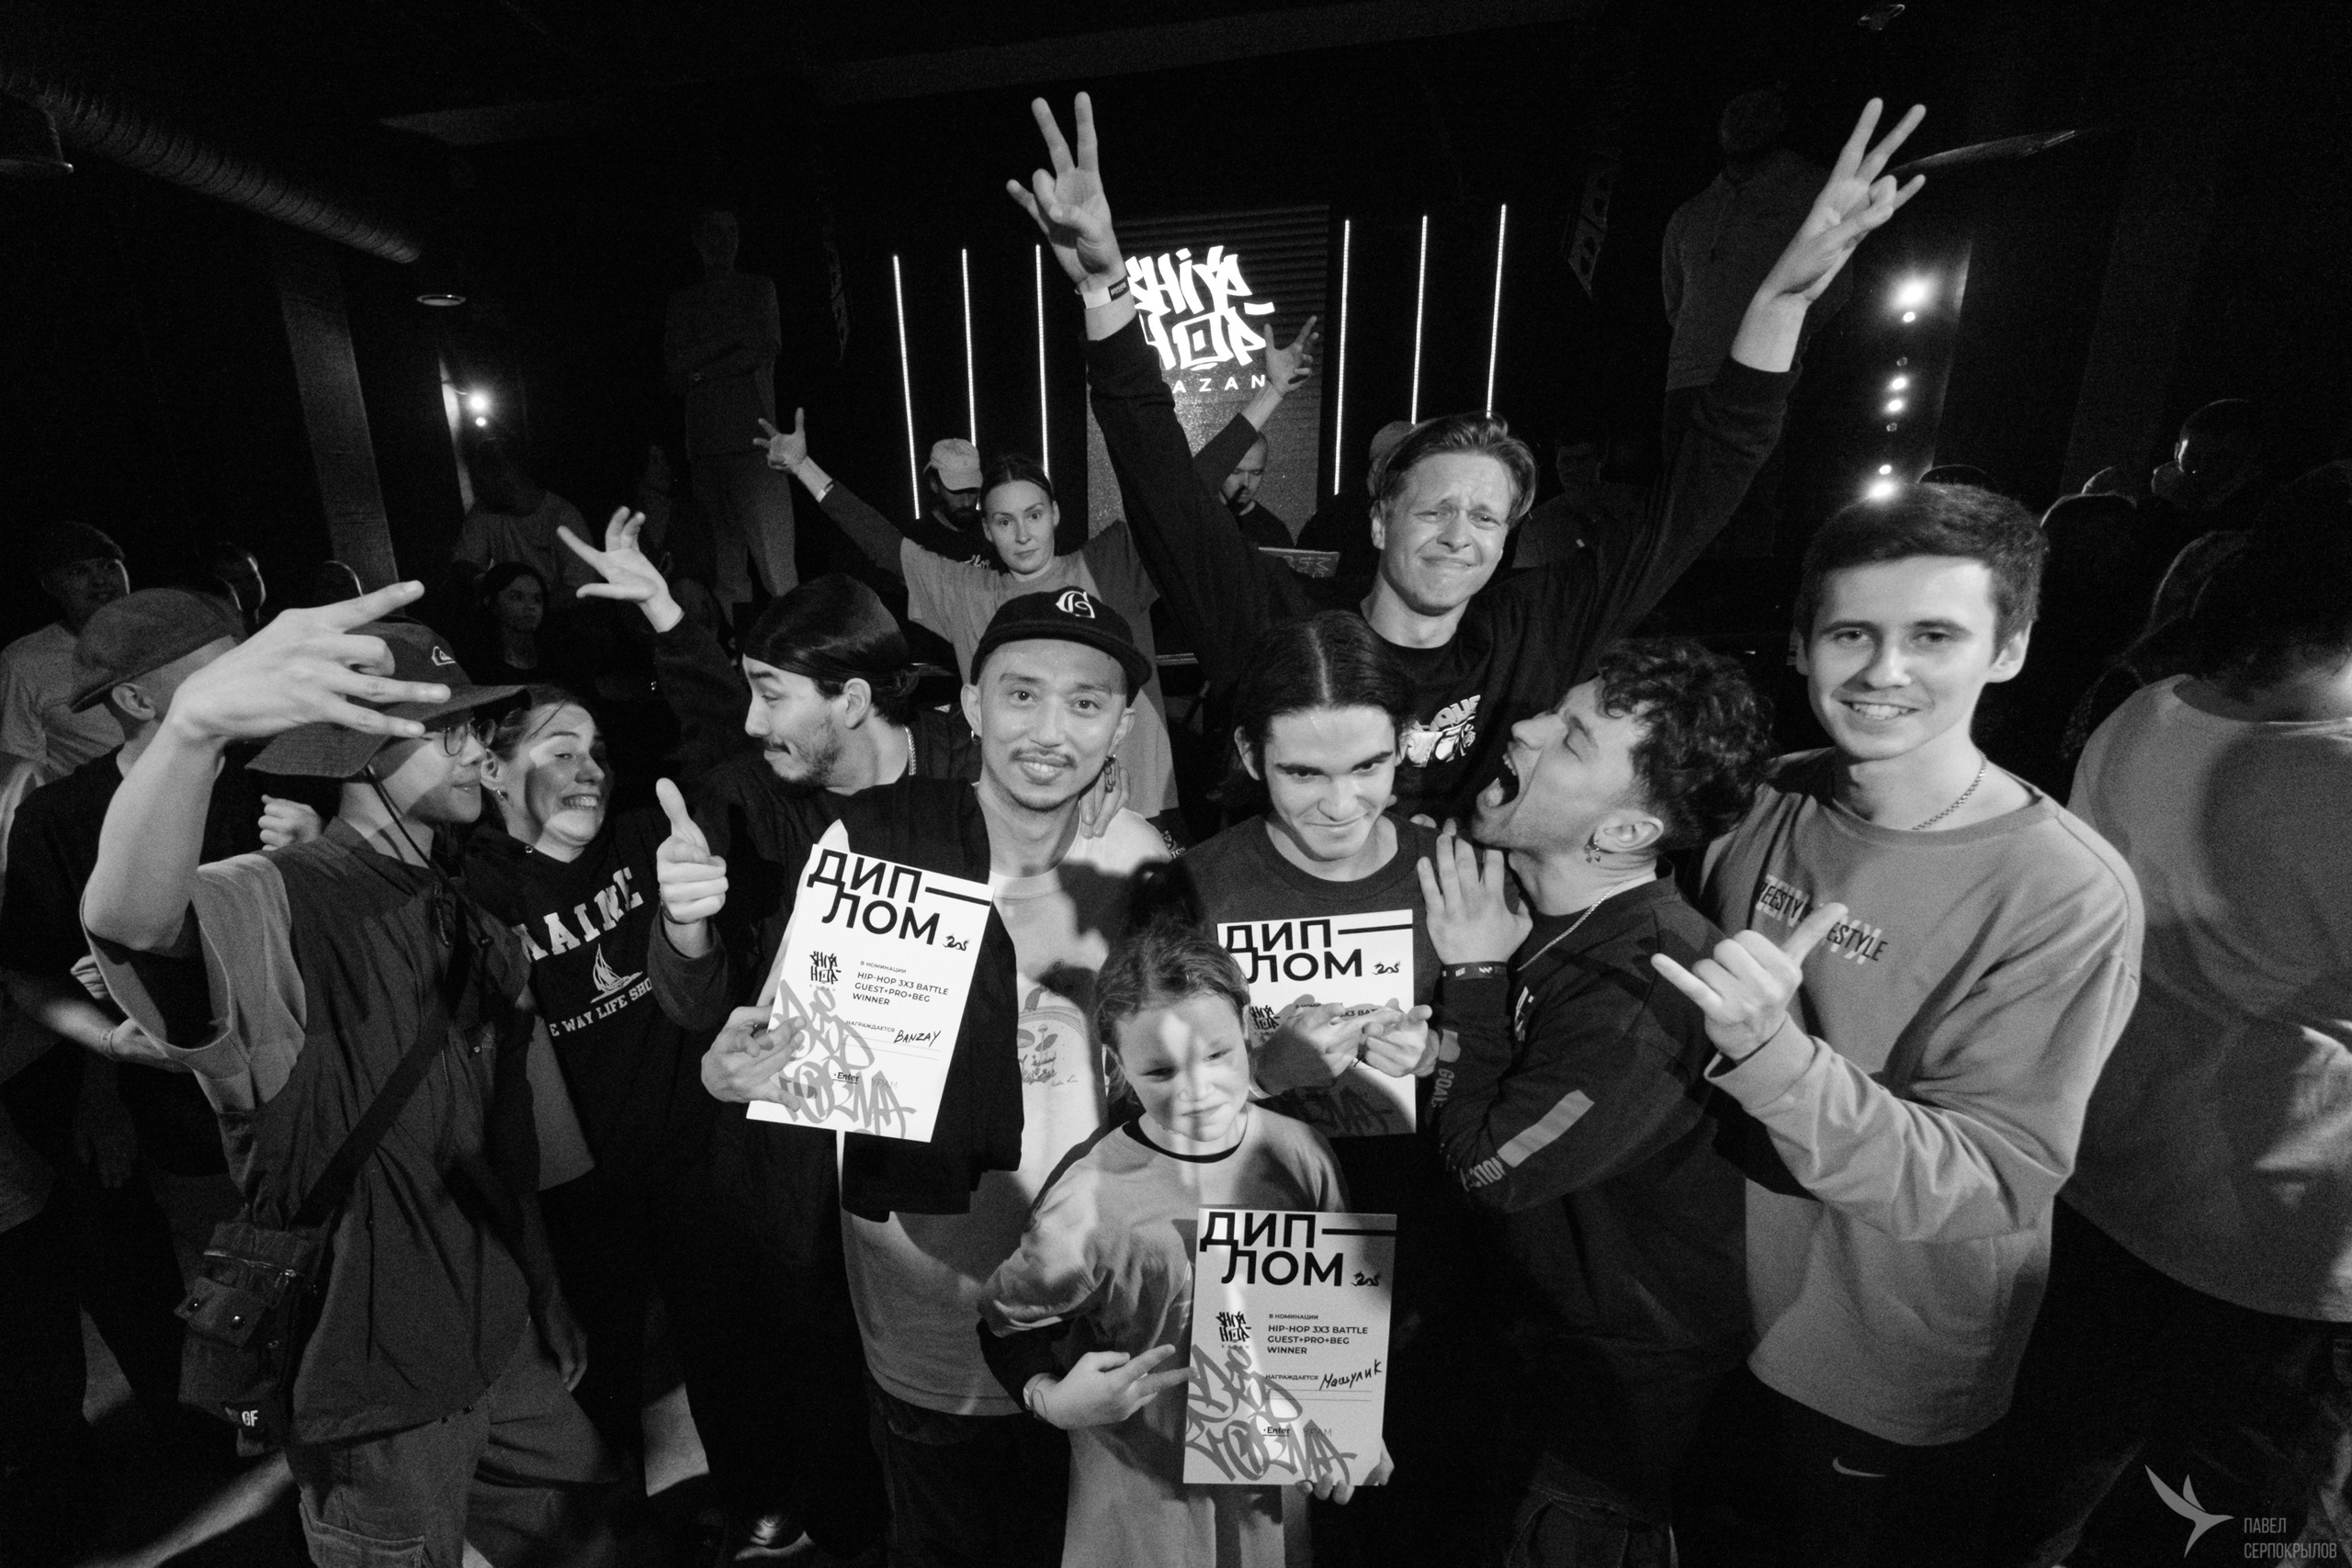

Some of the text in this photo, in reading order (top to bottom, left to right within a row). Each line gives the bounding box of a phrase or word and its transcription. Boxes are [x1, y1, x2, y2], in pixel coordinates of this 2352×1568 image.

[1172, 374, 1265, 394] AZAN
[821, 890, 941, 945] ЛОМ
[866, 962, 907, 974] НОМИНАЦИИ
[1248, 949, 1363, 984] ЛОМ
[857, 972, 897, 985] HIP-HOP
[916, 983, 949, 996] BATTLE
[853, 993, 890, 1006] WINNER
[854, 982, 931, 1002] GUEST+PRO+BEG
[561, 1011, 594, 1032] WAY
[596, 994, 628, 1019] LIFE
[845, 1021, 896, 1032] НАГРАЖДАЕТСЯ
[893, 1029, 942, 1047] BANZAY
[837, 1072, 860, 1082] Enter
[1220, 1249, 1344, 1287] ЛОМ
[1268, 1325, 1310, 1333] HIP-HOP
[1267, 1335, 1350, 1345] GUEST+PRO+BEG
[1267, 1346, 1307, 1354] WINNER
[1267, 1426, 1291, 1434] Enter
